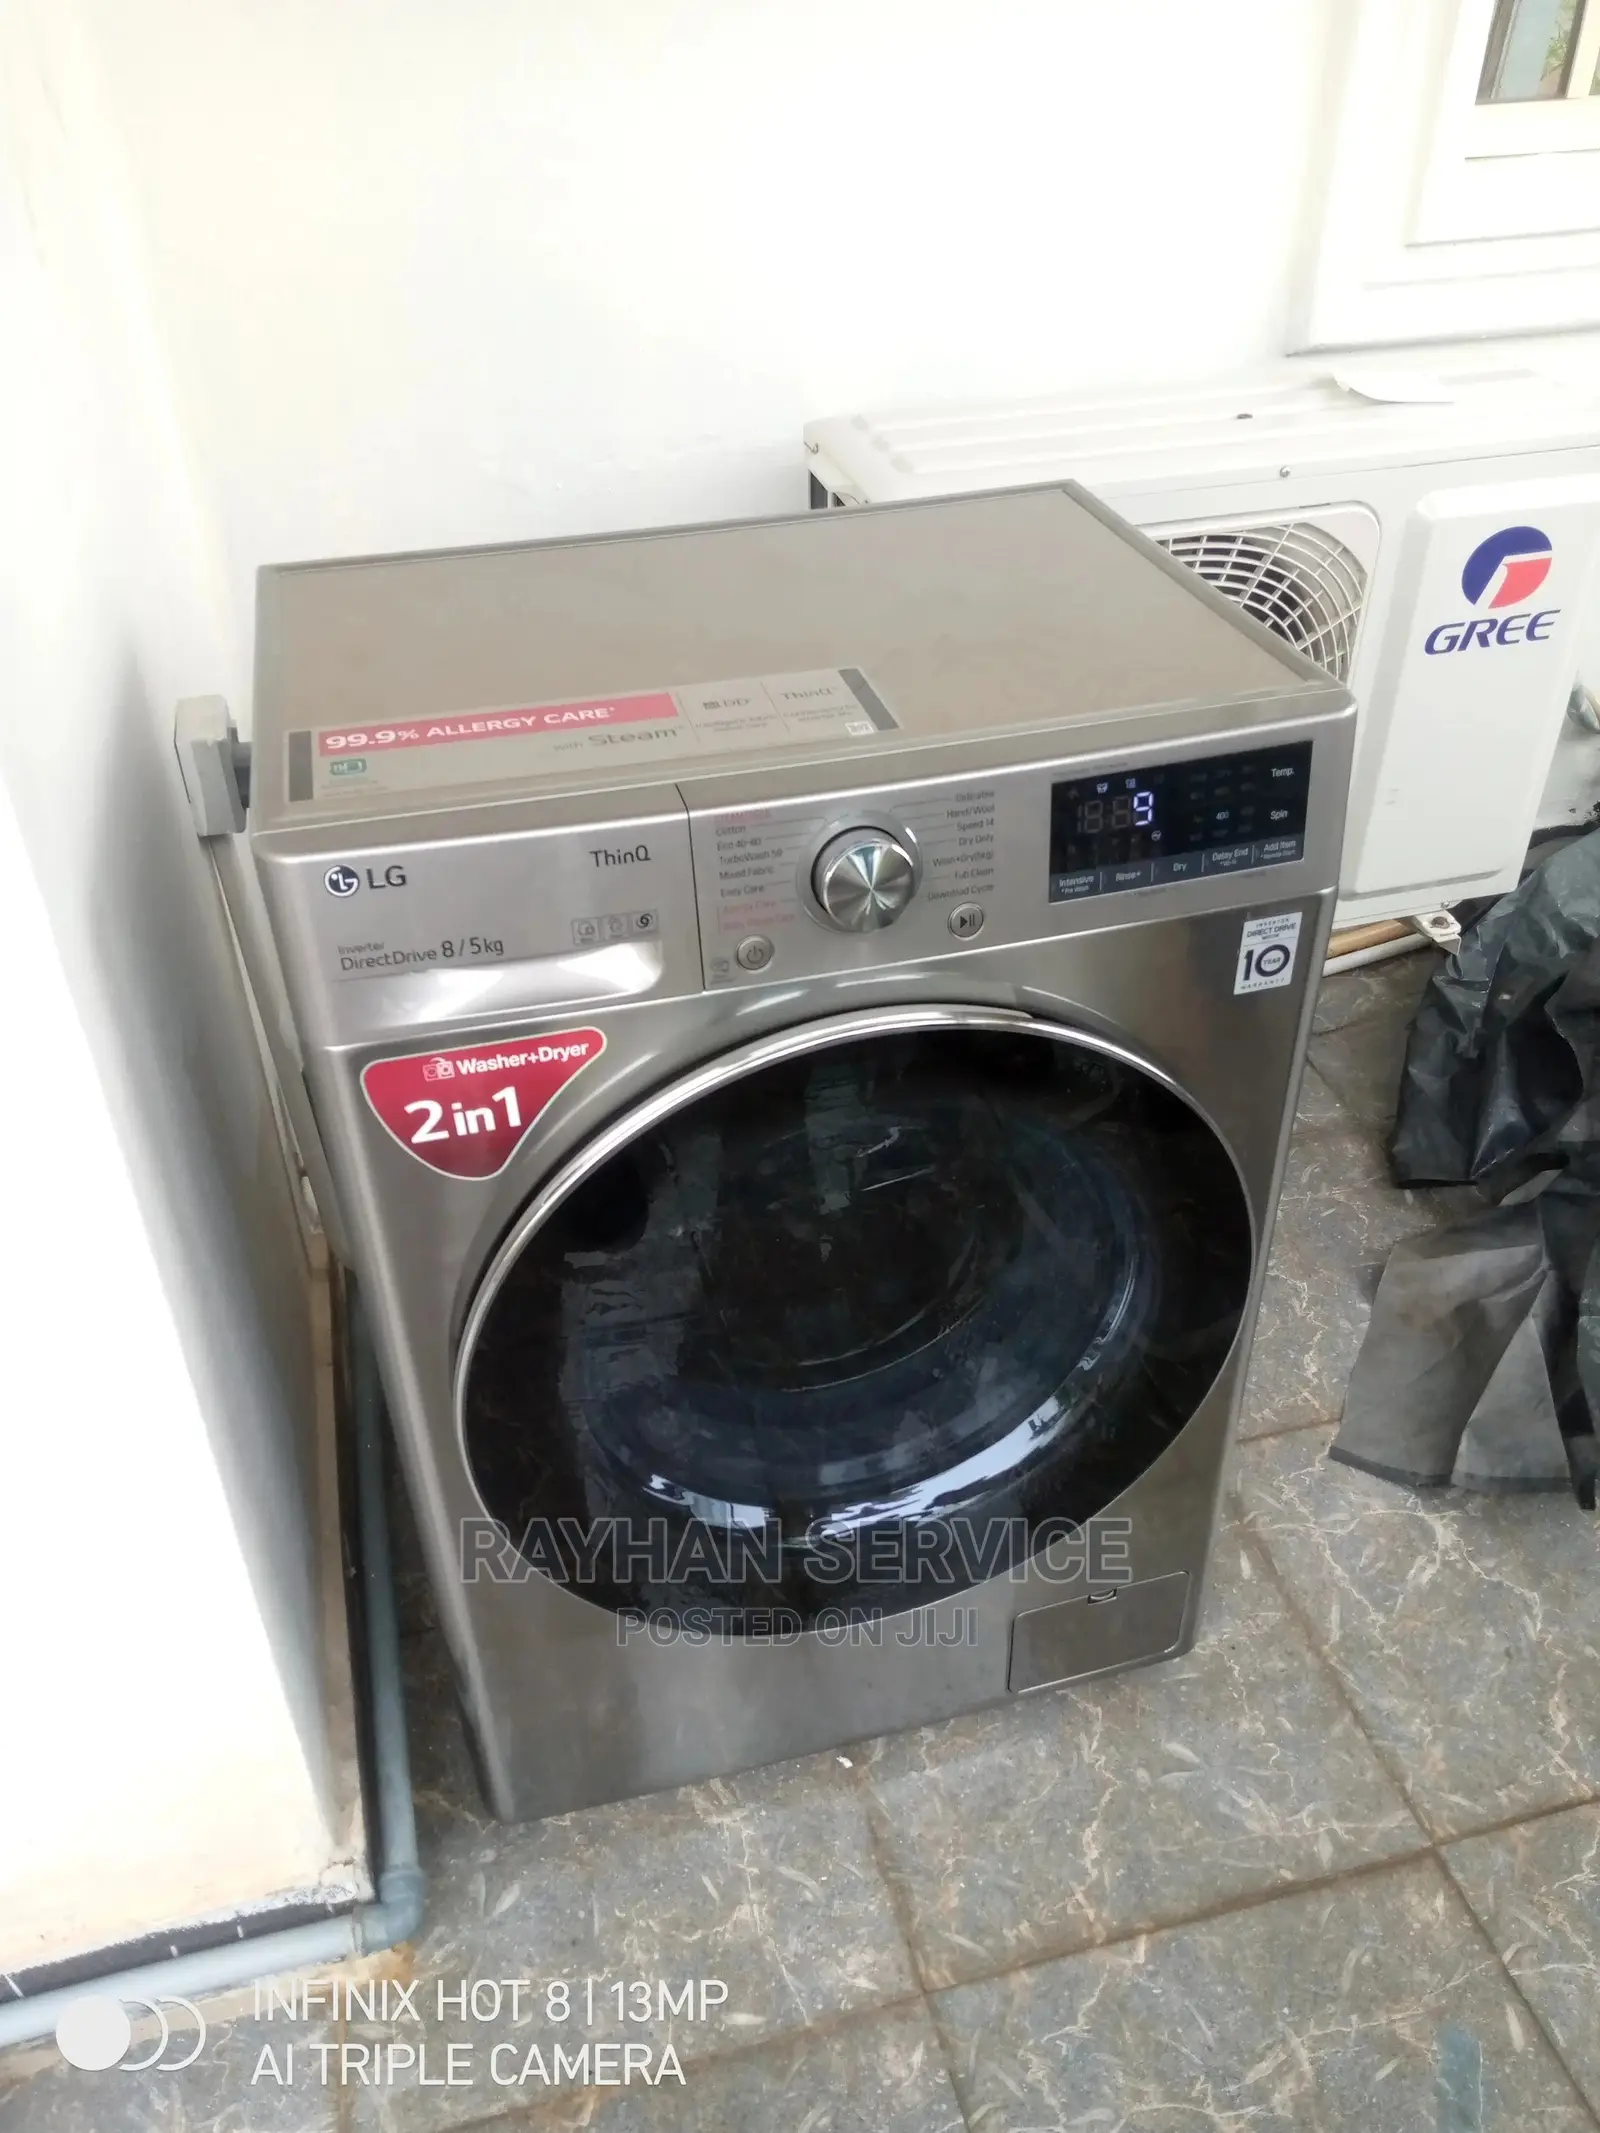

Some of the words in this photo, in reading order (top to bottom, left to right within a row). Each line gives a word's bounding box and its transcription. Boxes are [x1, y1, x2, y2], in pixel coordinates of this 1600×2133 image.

[1424, 608, 1561, 655] GREE
[326, 729, 420, 750] 99.9%
[426, 716, 536, 738] ALLERGY
[1271, 767, 1294, 778] Temp.
[947, 804, 995, 818] Hand/Wool
[1270, 809, 1289, 820] Spin
[715, 825, 747, 837] Cotton
[957, 820, 984, 832] Speed
[958, 836, 974, 847] Dry
[975, 833, 994, 844] Only
[1264, 841, 1279, 852] Add
[589, 845, 652, 868] ThinQ
[1212, 850, 1233, 862] Delay
[1234, 847, 1249, 858] End
[1172, 862, 1188, 872] Dry
[366, 866, 408, 890] LG
[719, 869, 746, 881] Mixed
[1058, 875, 1095, 887] Intensive
[1246, 927, 1273, 938] DIRECT
[1274, 922, 1297, 933] DRIVE
[338, 940, 386, 955] Inverter
[1243, 944, 1291, 981] 10
[456, 1042, 589, 1076] Washer+Dryer
